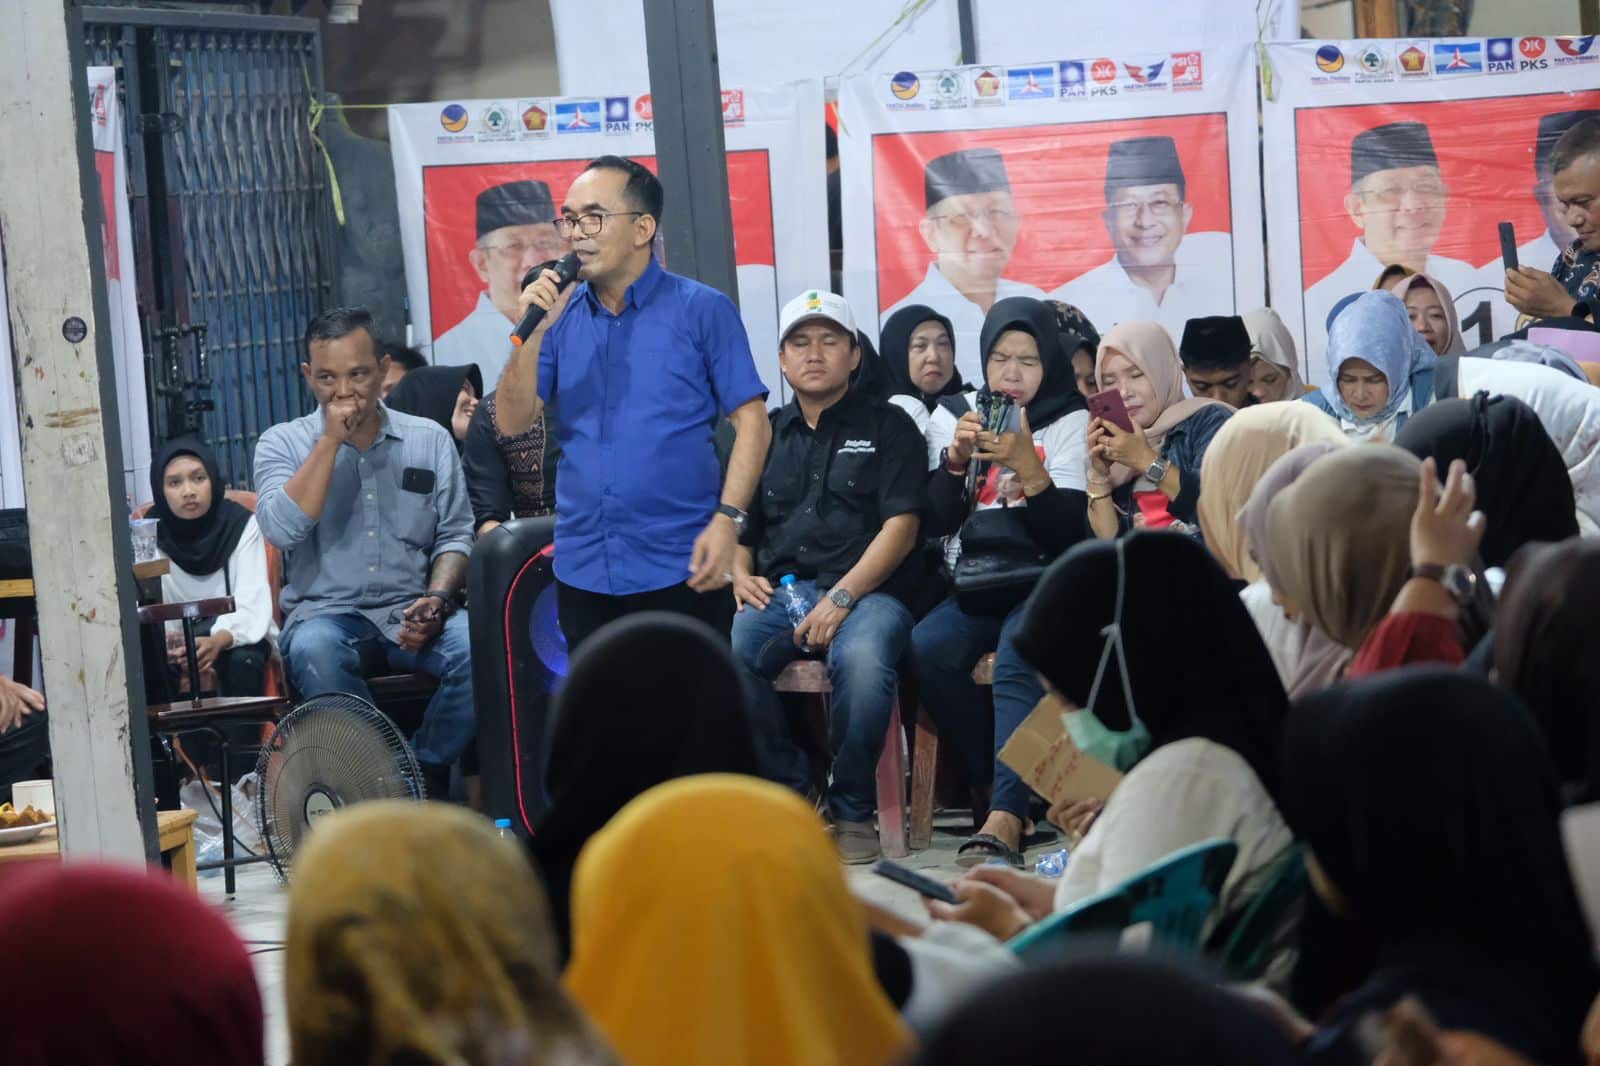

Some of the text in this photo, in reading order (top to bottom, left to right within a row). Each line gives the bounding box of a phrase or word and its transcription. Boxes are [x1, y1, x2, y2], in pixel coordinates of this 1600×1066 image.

[1488, 61, 1515, 72] PAN
[1520, 59, 1548, 71] PKS
[1091, 86, 1118, 97] PKS
[606, 121, 630, 132] PAN
[635, 122, 654, 132] PK
[1461, 301, 1493, 345] 1
